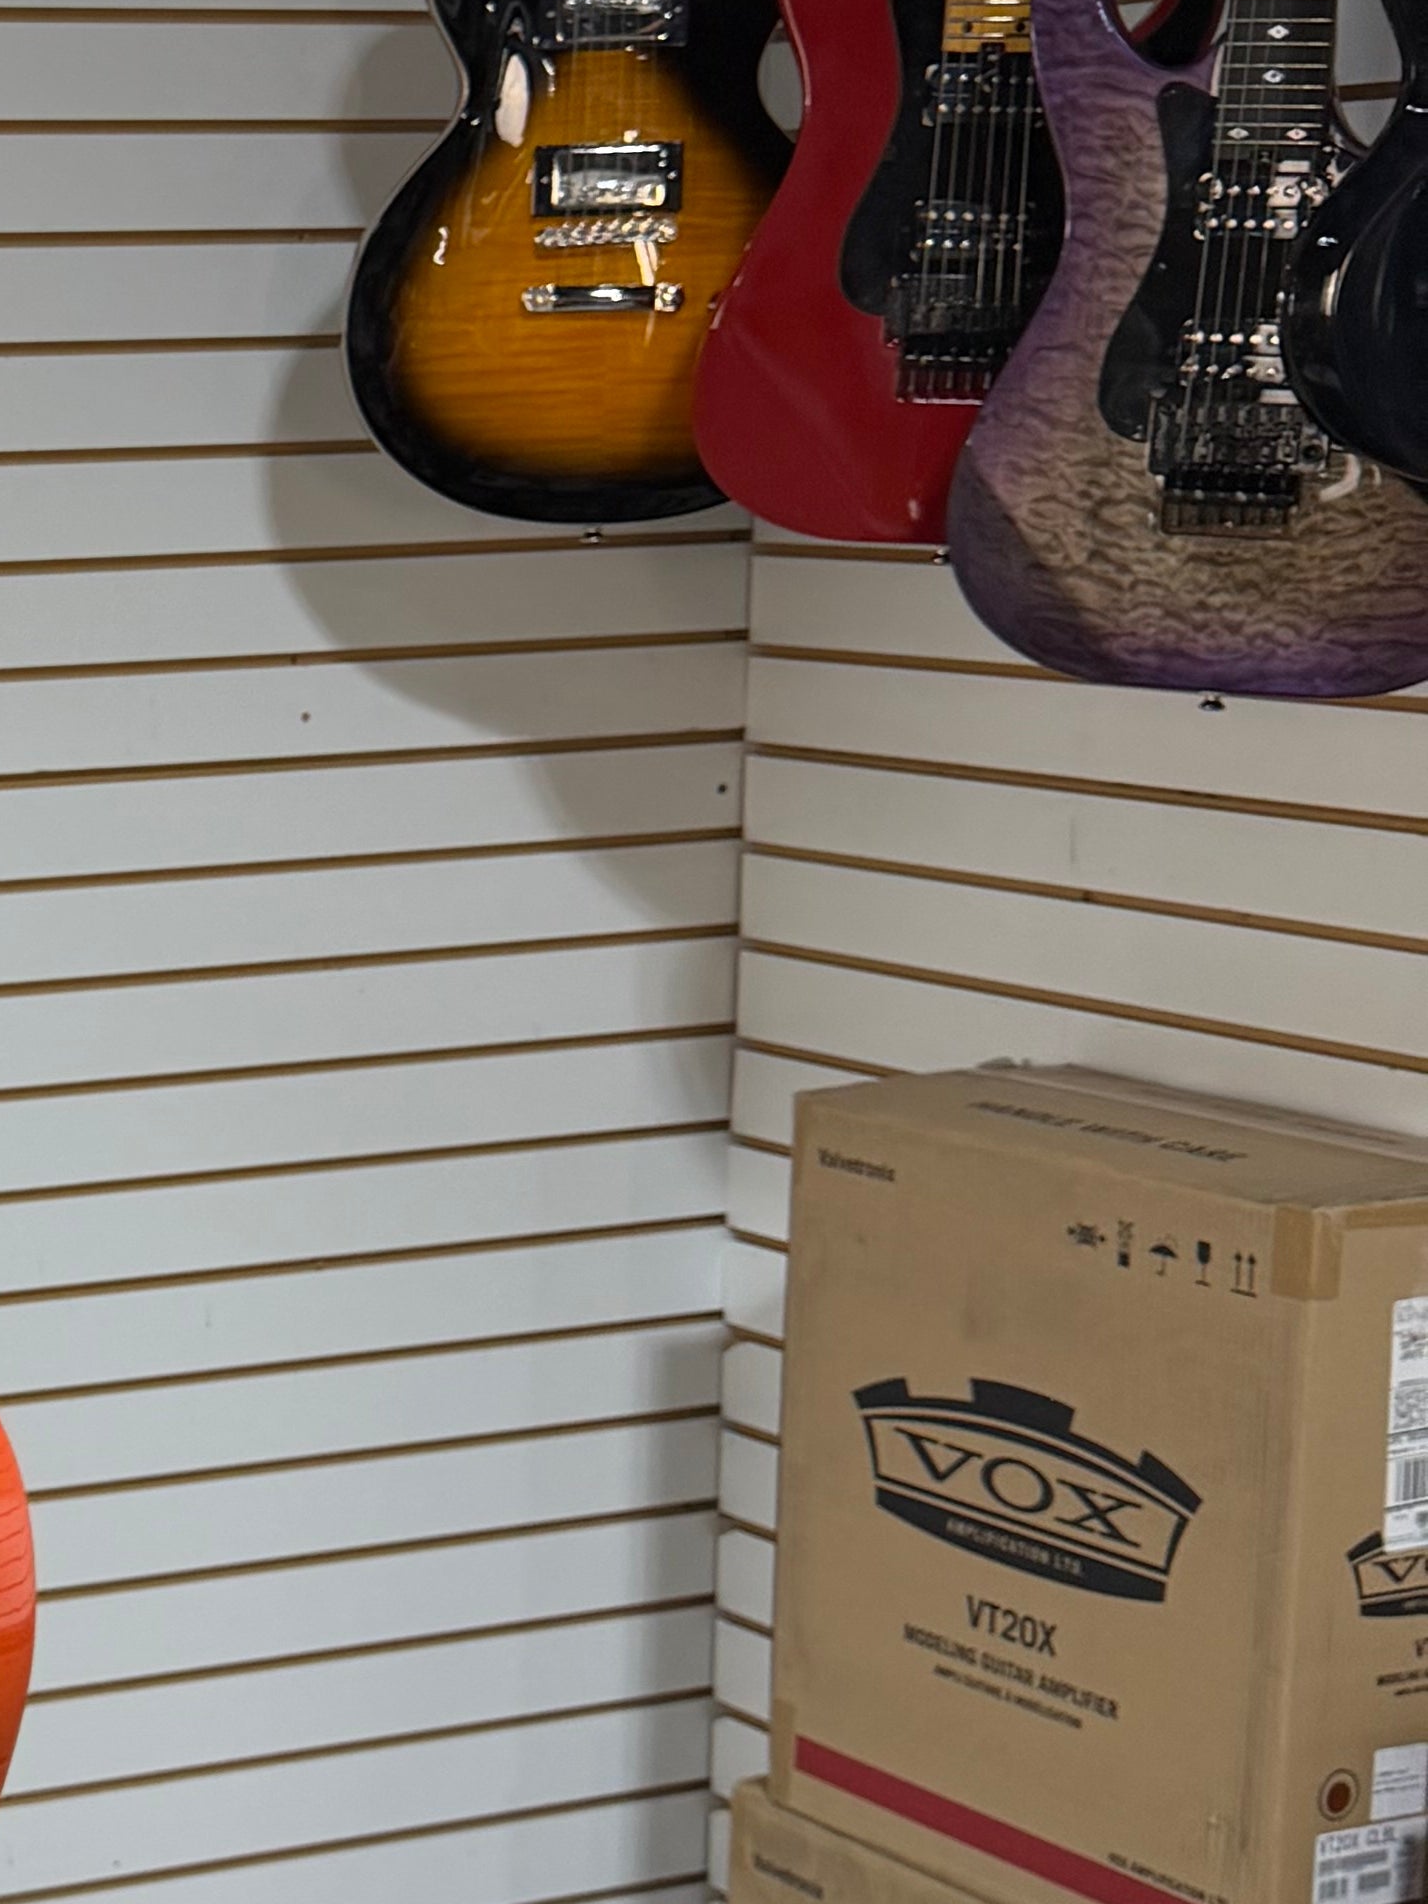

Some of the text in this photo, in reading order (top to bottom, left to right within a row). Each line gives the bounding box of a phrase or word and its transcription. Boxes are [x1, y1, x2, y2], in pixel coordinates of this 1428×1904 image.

[895, 1426, 1143, 1549] VOX
[966, 1593, 1057, 1658] VT20X
[981, 1652, 1035, 1688] GUITAR
[1038, 1675, 1120, 1721] AMPLIFIER
